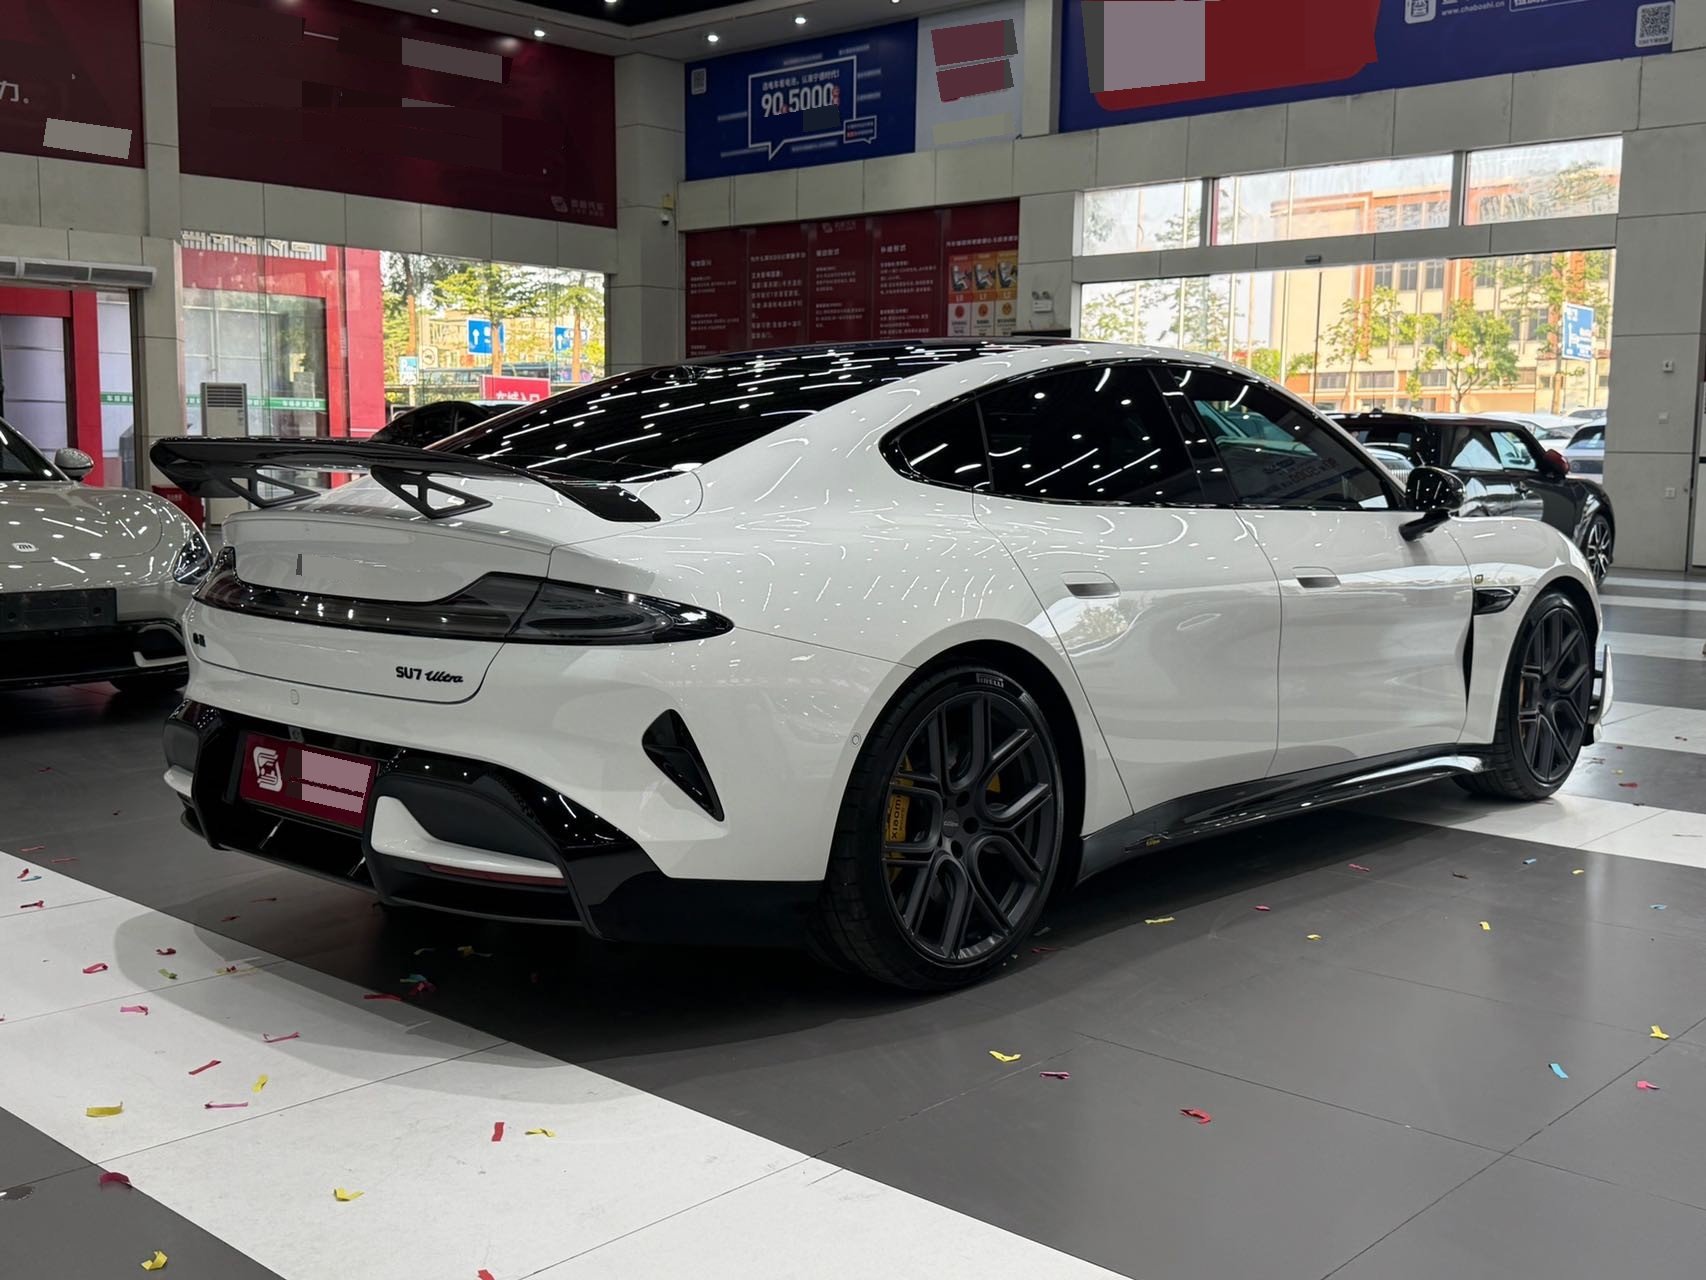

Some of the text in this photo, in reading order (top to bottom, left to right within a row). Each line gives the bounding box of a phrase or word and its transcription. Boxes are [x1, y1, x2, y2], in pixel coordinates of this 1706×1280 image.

[1441, 1, 1505, 16] www.chaboshi.cn
[395, 666, 464, 684] SU7 Ultra
